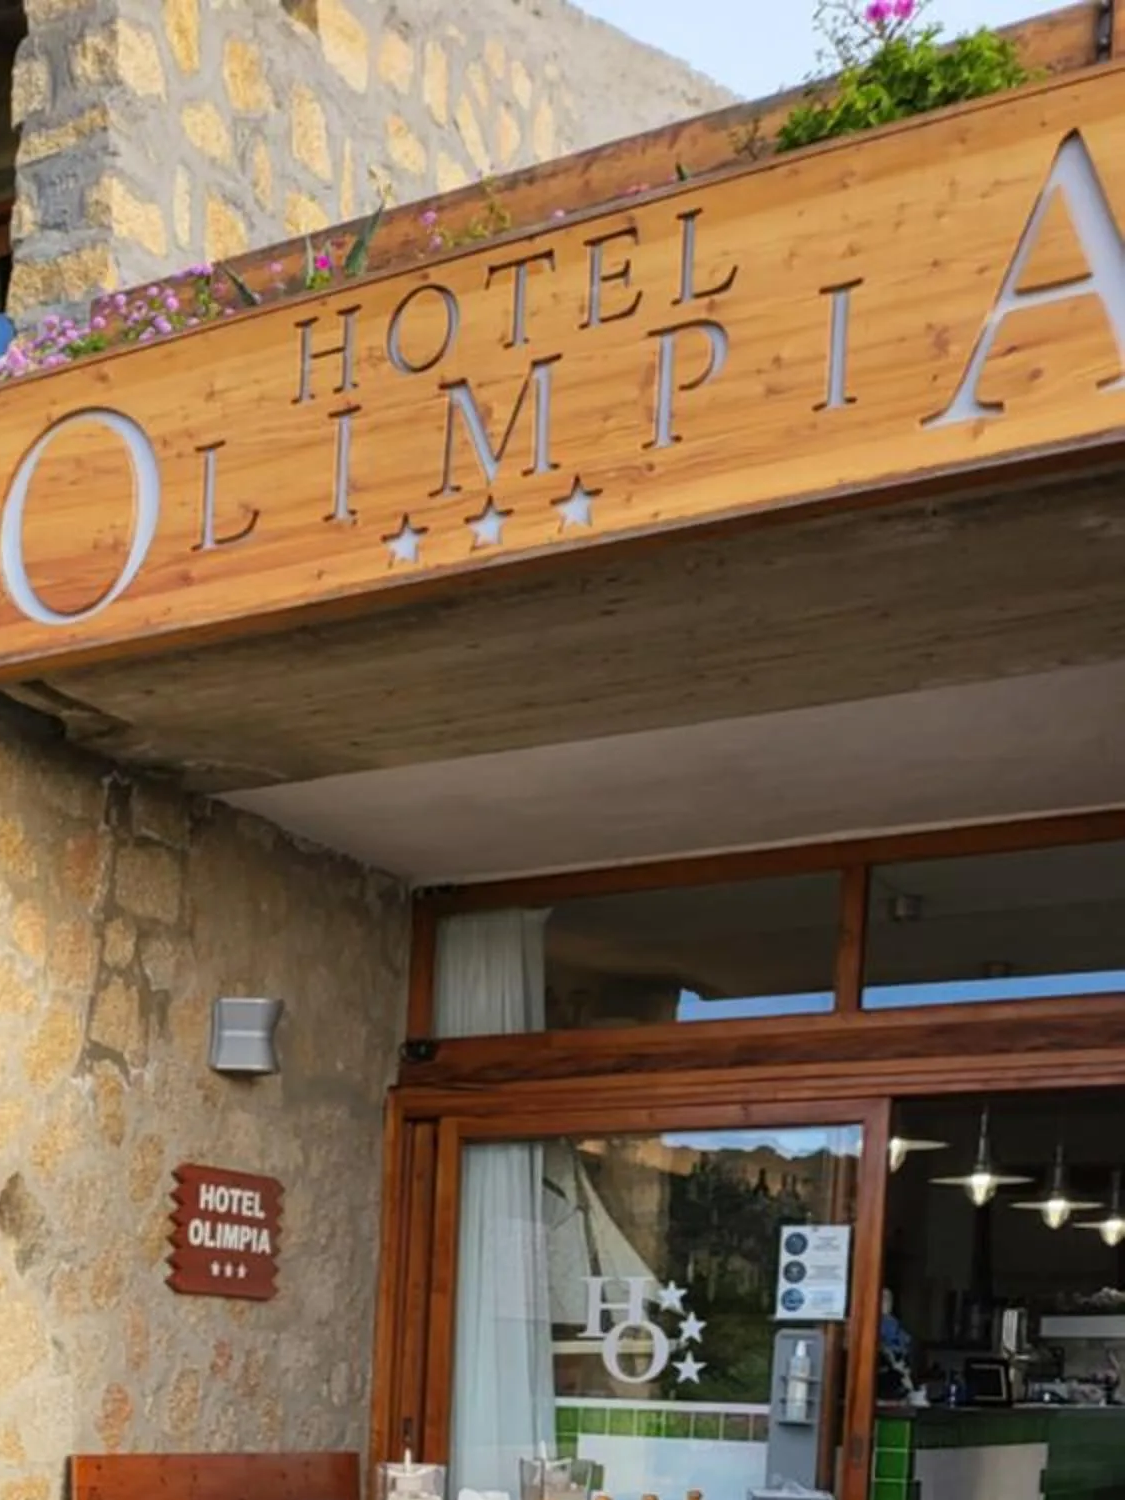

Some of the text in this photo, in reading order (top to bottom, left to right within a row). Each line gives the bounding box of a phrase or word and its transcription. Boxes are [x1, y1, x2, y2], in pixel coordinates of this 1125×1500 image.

[291, 207, 738, 405] HOTEL
[198, 1183, 266, 1219] HOTEL
[187, 1218, 272, 1255] OLIMPIA
